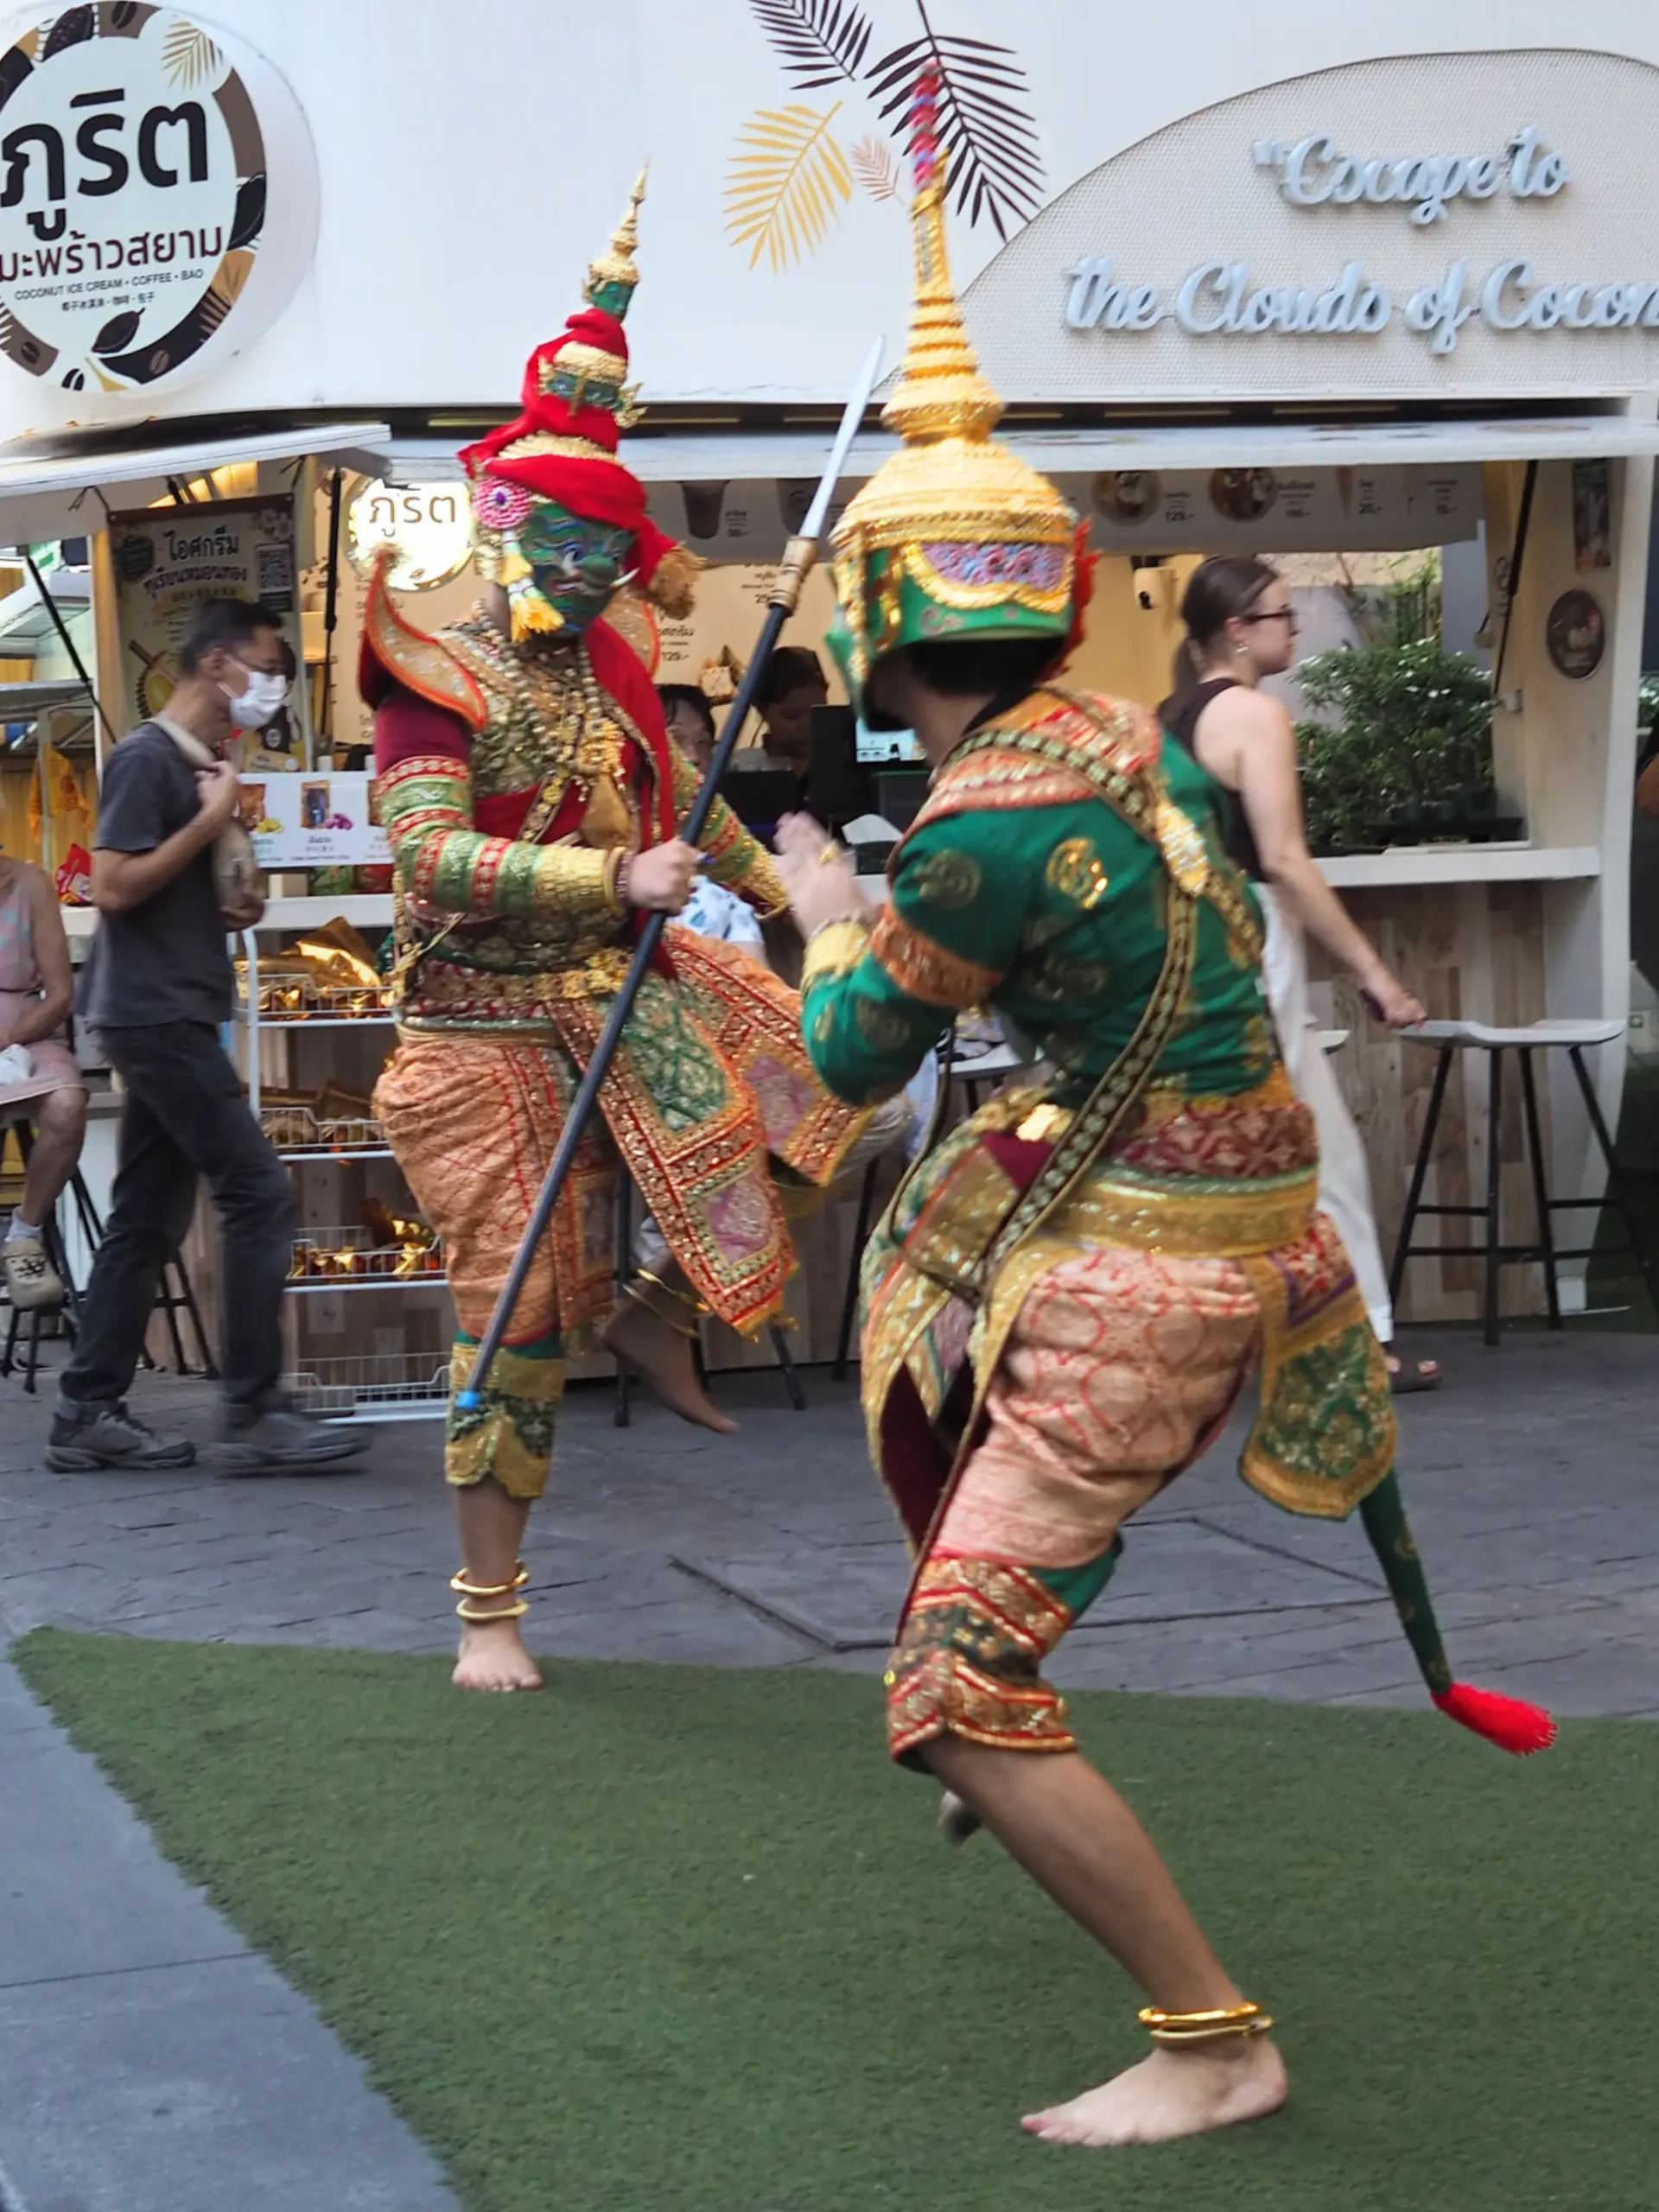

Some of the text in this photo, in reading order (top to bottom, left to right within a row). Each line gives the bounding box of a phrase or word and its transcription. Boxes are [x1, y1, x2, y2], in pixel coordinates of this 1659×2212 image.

[0, 88, 208, 241] ภูริต
[1508, 125, 1569, 198] to
[15, 269, 204, 301] COCONUT ICE CREAM COFFEE BAO
[1177, 259, 1392, 334] Clouds
[1403, 258, 1471, 355] of
[162, 524, 240, 561] ไอศกรีม
